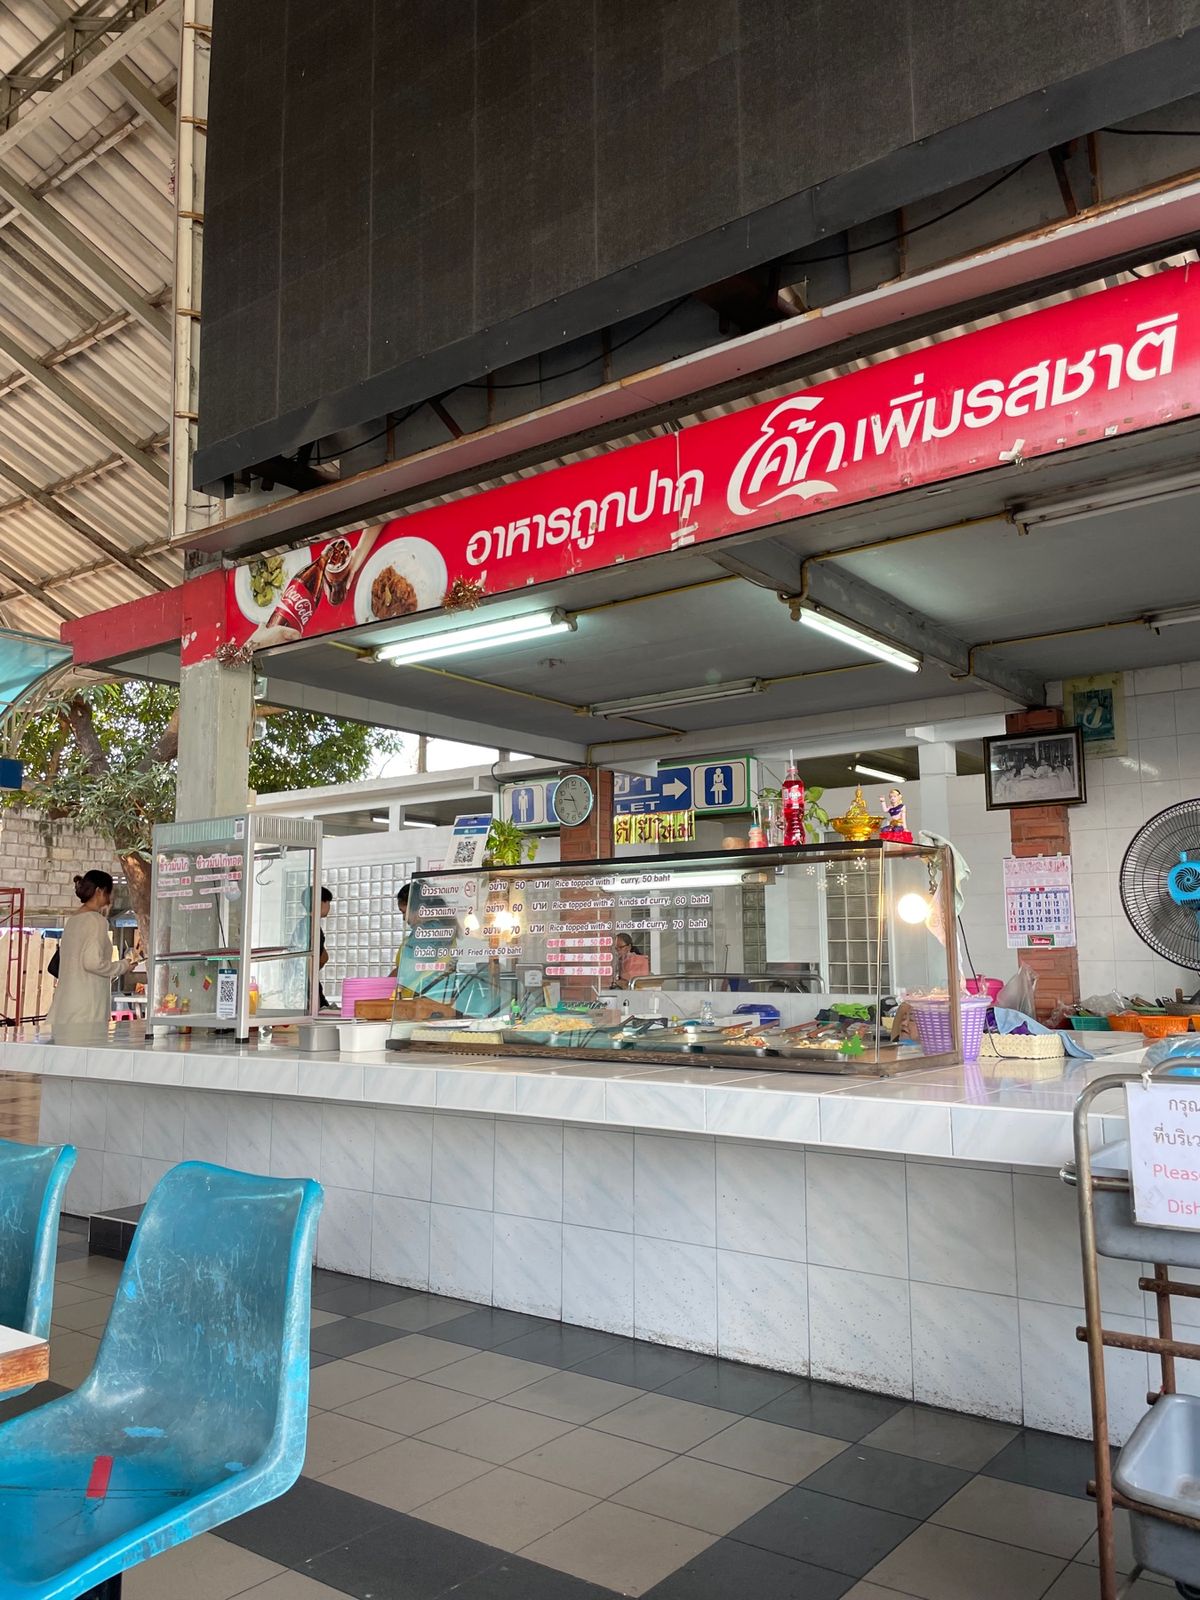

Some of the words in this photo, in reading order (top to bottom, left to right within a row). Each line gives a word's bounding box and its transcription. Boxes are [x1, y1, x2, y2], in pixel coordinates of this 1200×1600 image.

[466, 466, 704, 567] อาหารถูกปาก
[853, 312, 1178, 462] เพิ่มรสชาติ
[281, 584, 313, 626] Coca-Cola
[422, 885, 459, 896] ข้าวราดแกง
[489, 881, 507, 891] อย่าง
[515, 881, 525, 889] 50
[570, 879, 594, 889] topped
[420, 906, 456, 916] ข้าวราดแกง
[512, 904, 522, 912] 60
[569, 900, 591, 910] topped
[691, 895, 708, 903] baht
[416, 927, 454, 937] ข้าวราดแกง
[510, 926, 520, 934] 70
[530, 925, 544, 933] บาท
[566, 924, 588, 933] topped
[673, 920, 683, 928] 70
[689, 919, 707, 927] baht
[438, 948, 448, 956] 50
[468, 948, 483, 956] Fried
[1153, 1164, 1200, 1181] Pleas
